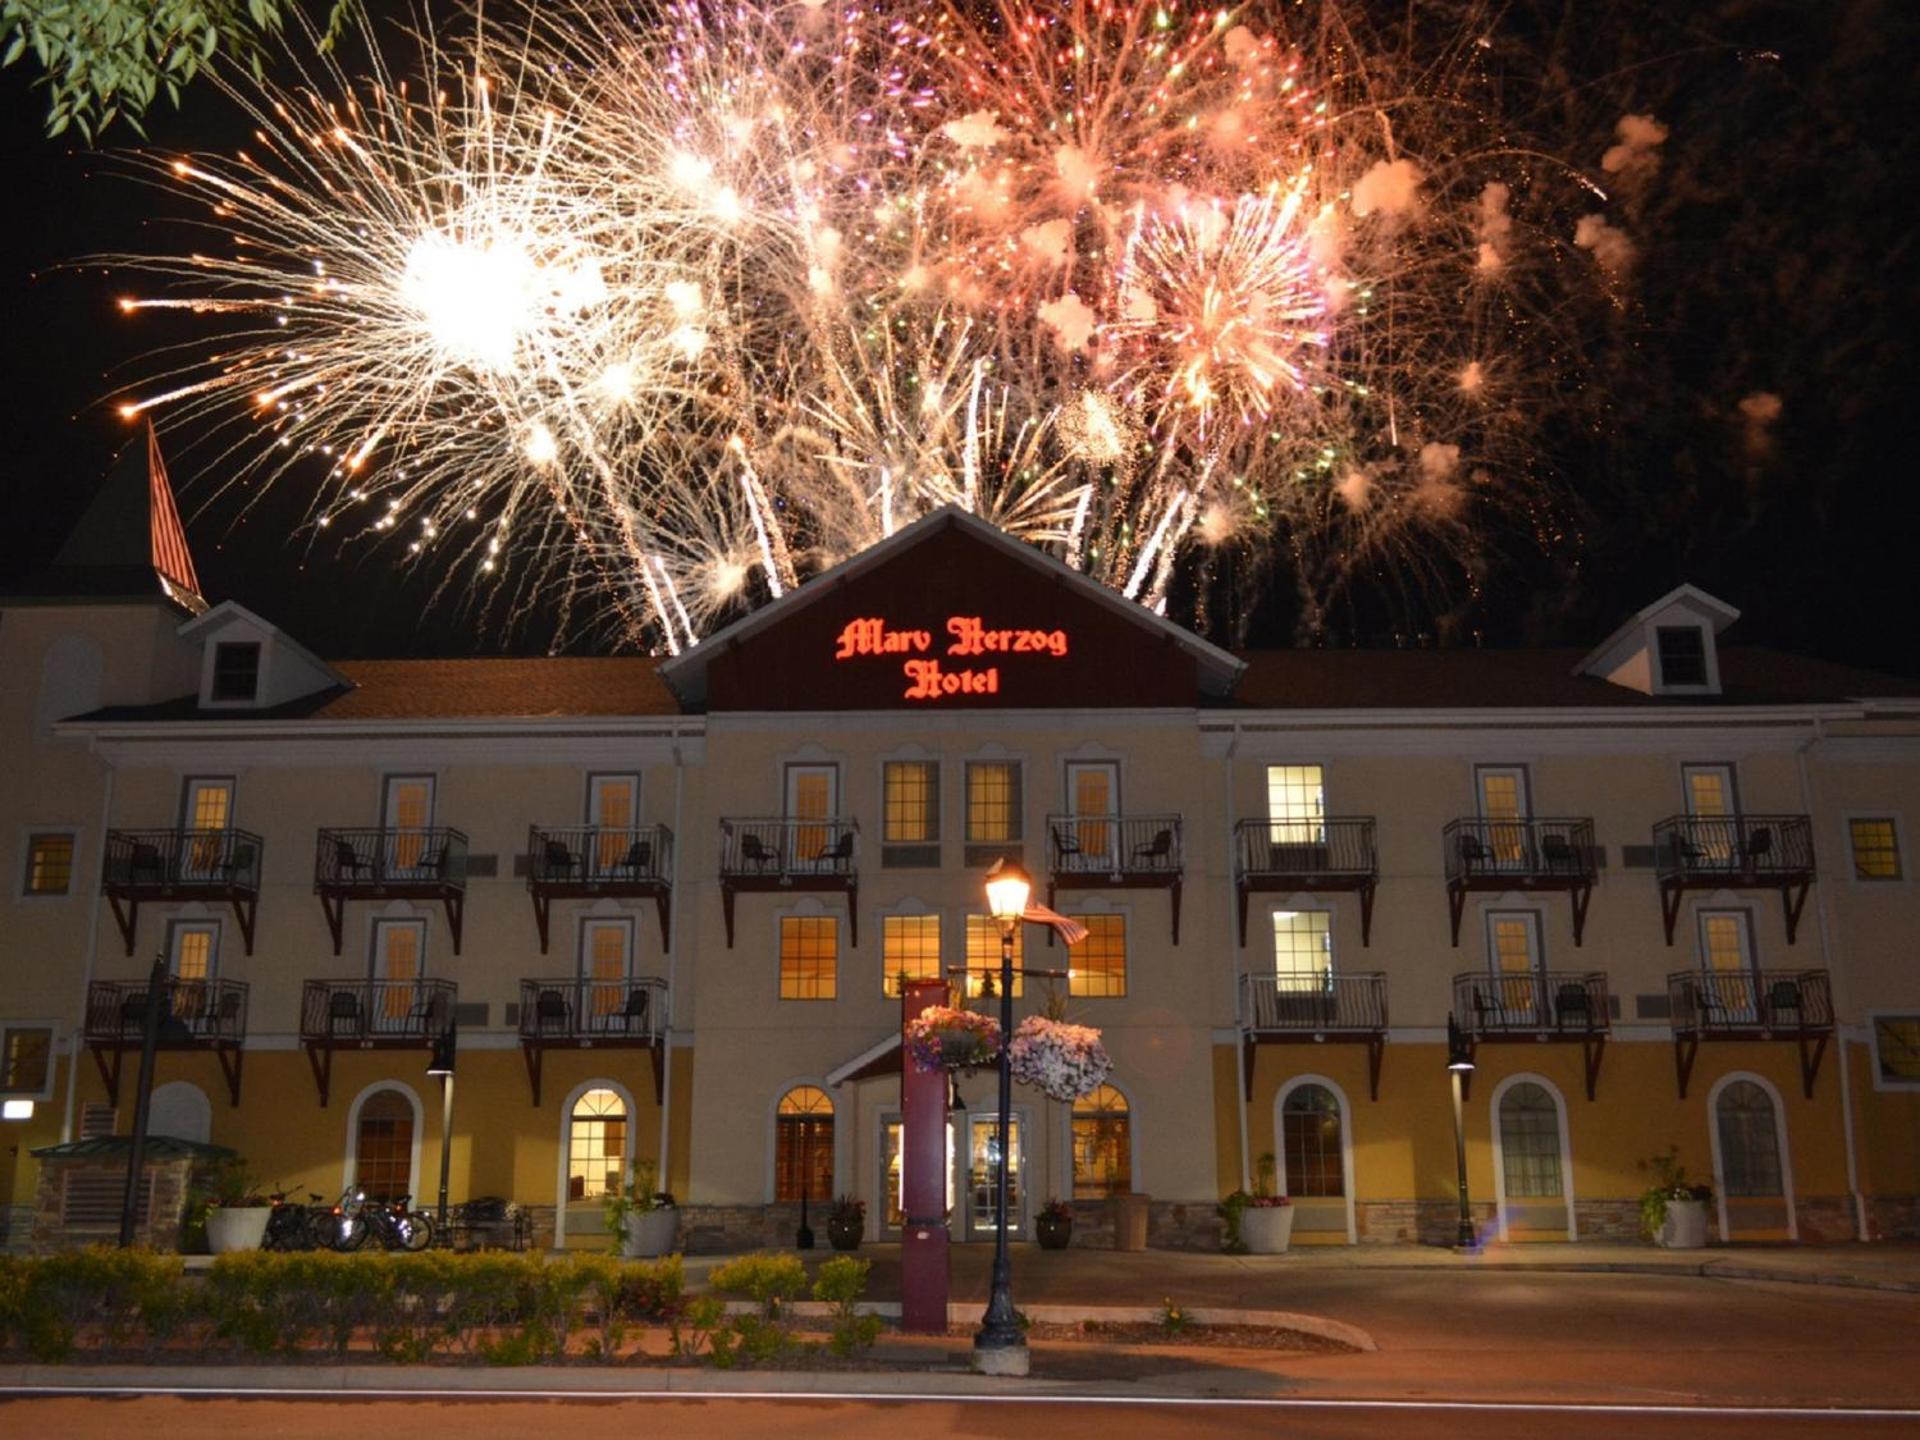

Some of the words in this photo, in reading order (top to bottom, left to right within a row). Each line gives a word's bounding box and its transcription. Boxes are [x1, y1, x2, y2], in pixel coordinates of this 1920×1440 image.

[836, 618, 931, 660] Marv
[947, 617, 1068, 656] Herzog
[904, 659, 999, 699] Hotel
